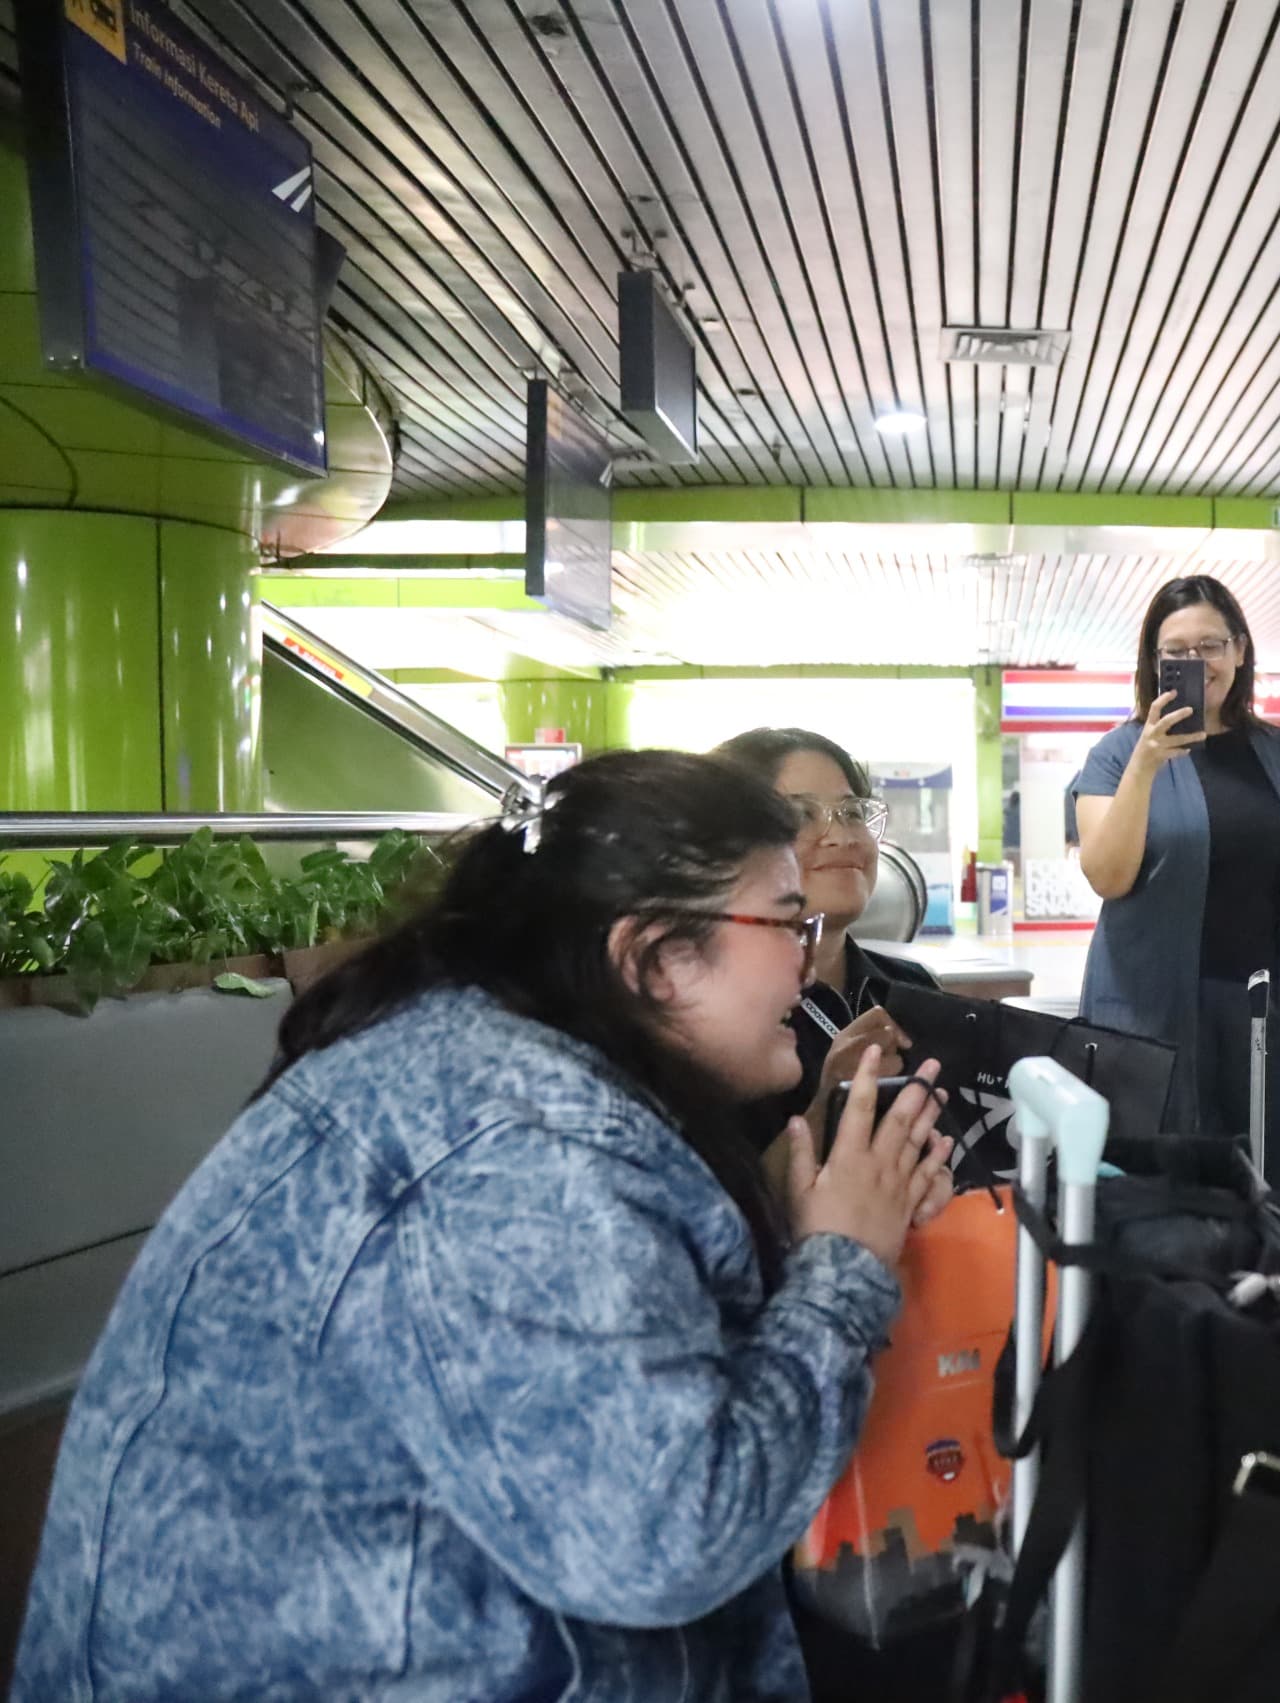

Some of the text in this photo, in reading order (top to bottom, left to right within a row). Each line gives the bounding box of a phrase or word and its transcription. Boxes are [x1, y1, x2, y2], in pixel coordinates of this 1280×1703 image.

[130, 2, 260, 133] Informasi Kereta Api
[133, 42, 221, 129] Train Information
